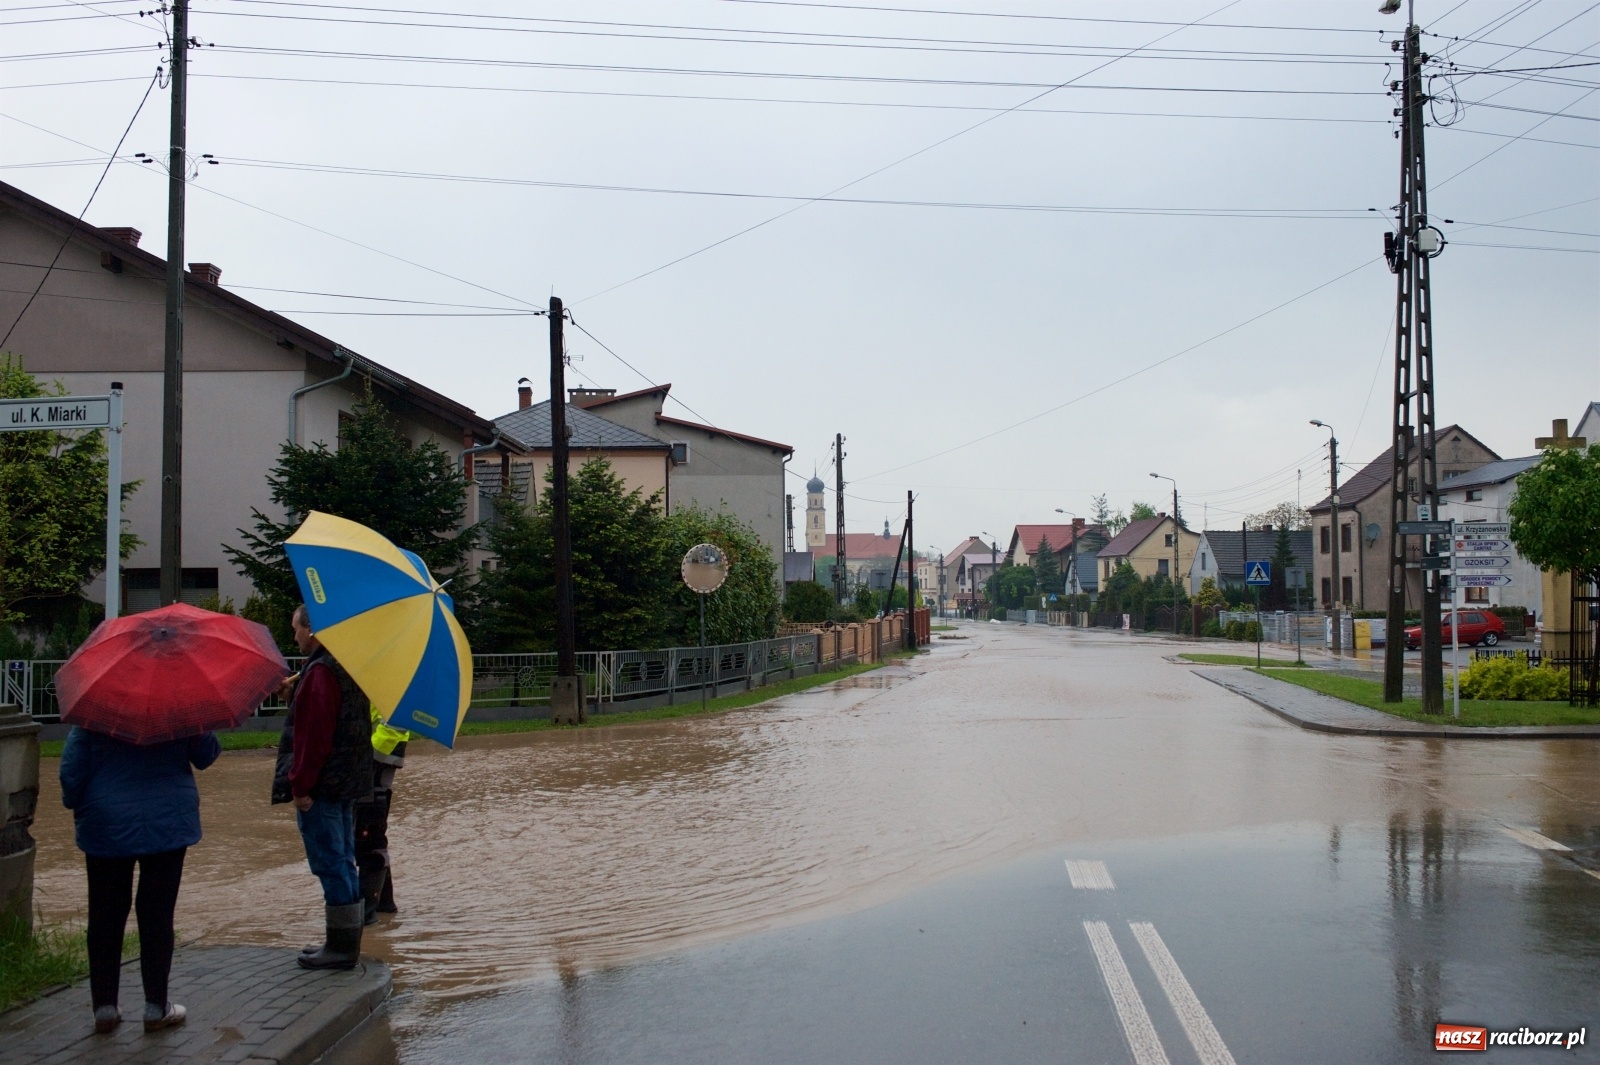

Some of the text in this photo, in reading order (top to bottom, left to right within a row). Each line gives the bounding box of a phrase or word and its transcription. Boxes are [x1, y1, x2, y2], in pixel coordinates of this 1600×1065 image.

[11, 405, 87, 423] ul. K. Miarki
[1466, 526, 1507, 534] Krzyżanowska
[307, 569, 323, 601] Praktiker
